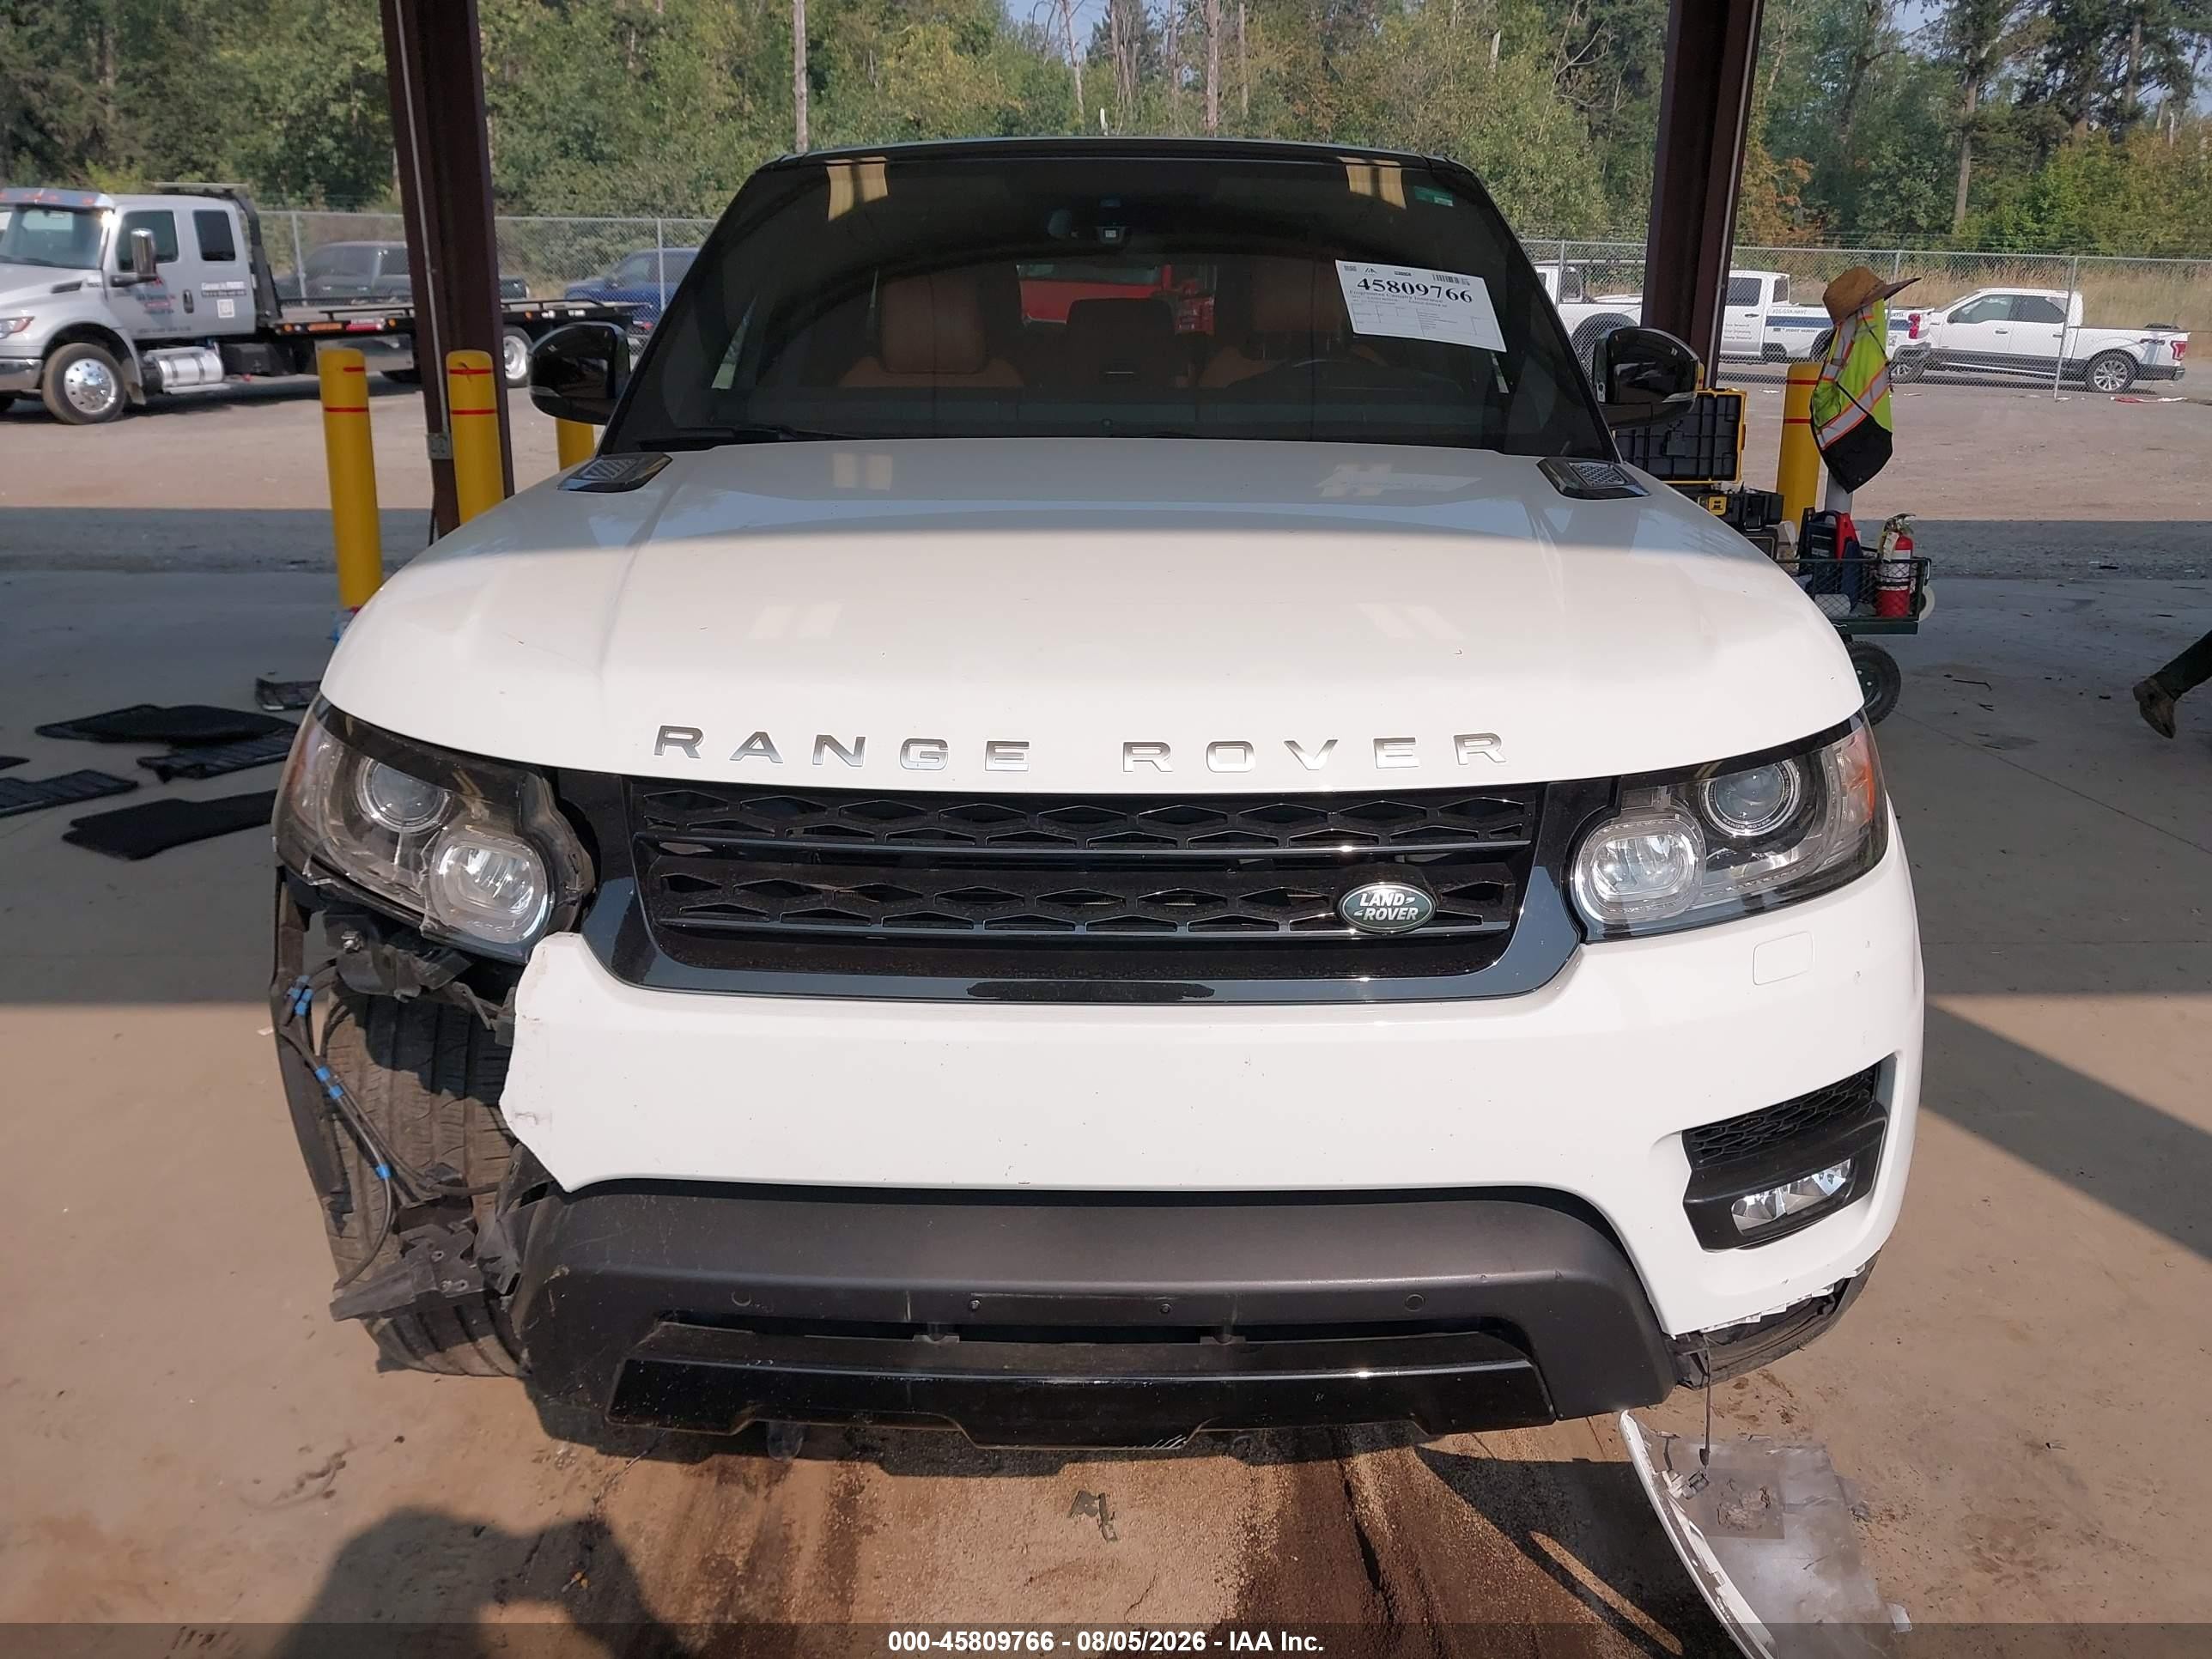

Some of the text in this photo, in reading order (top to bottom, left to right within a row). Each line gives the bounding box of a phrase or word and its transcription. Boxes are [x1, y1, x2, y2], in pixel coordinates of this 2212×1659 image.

[1357, 277, 1473, 304] 45809766
[653, 725, 1507, 773] RANGE ROVER
[1363, 907, 1419, 921] ROVER
